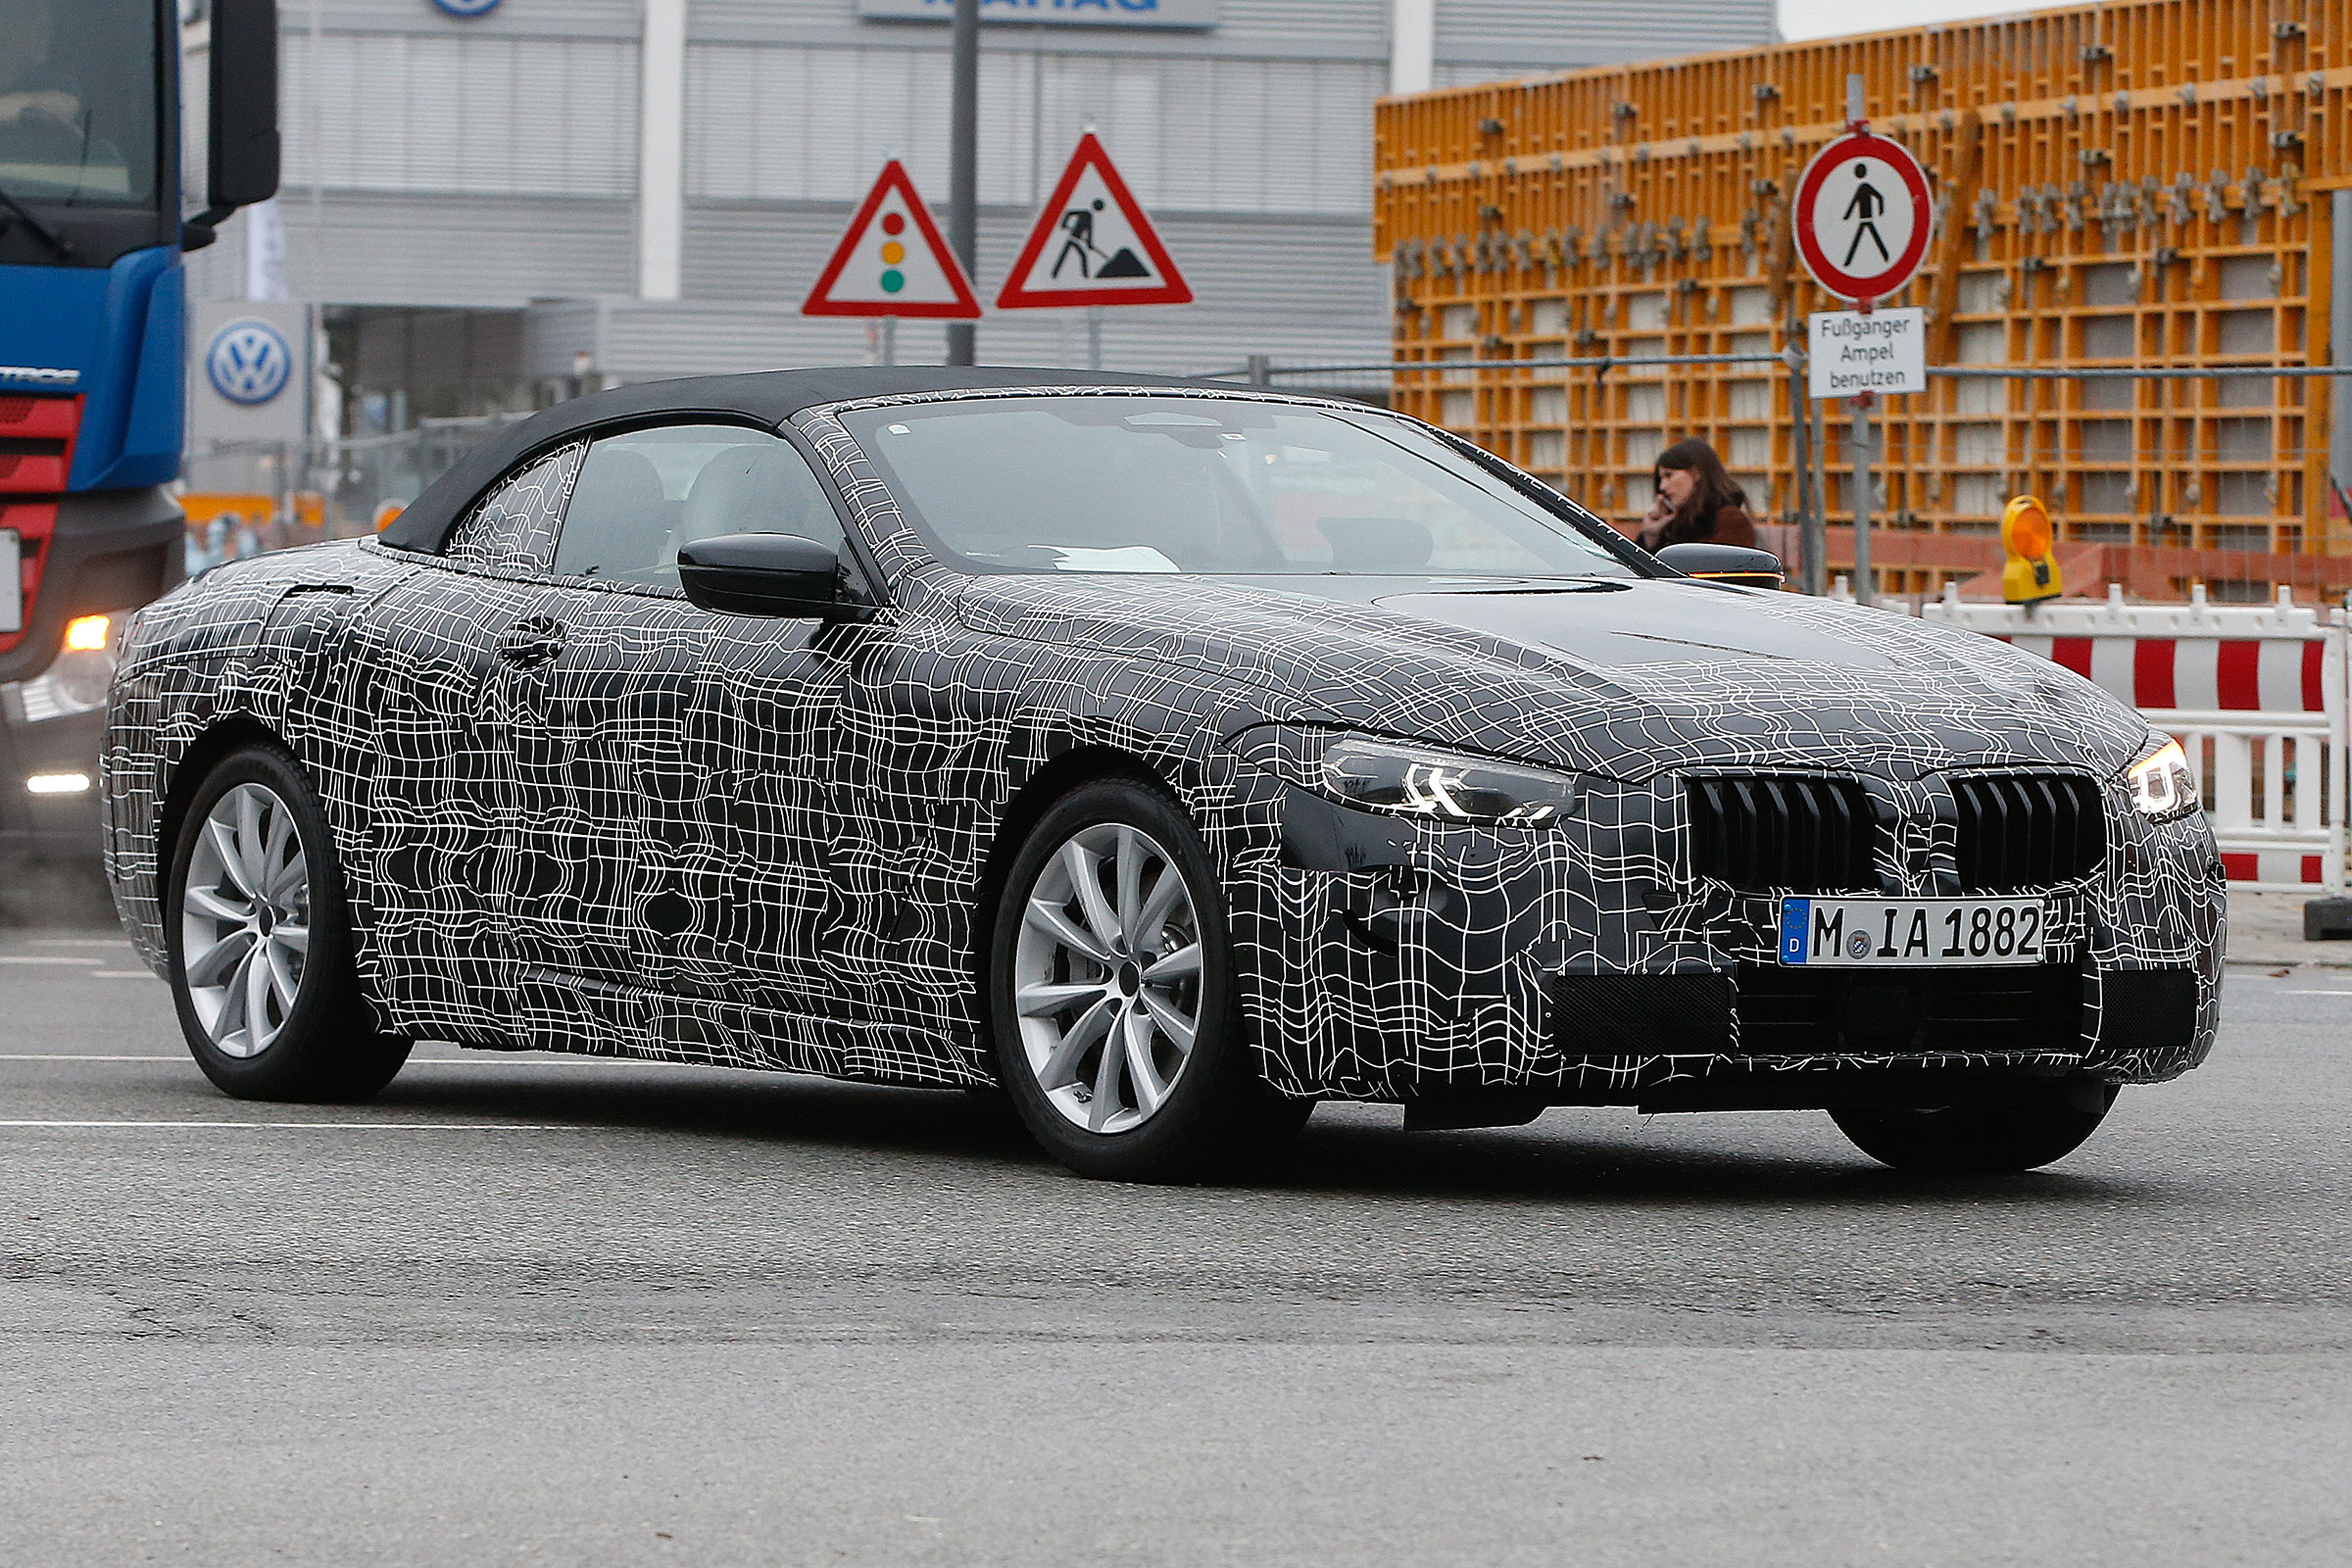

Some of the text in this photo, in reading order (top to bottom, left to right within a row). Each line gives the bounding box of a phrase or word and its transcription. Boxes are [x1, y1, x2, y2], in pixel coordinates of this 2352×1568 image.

[1840, 342, 1894, 365] Ampel
[1830, 369, 1905, 388] benutzen
[1813, 906, 2040, 957] M IA 1882
[1789, 938, 1800, 953] D
